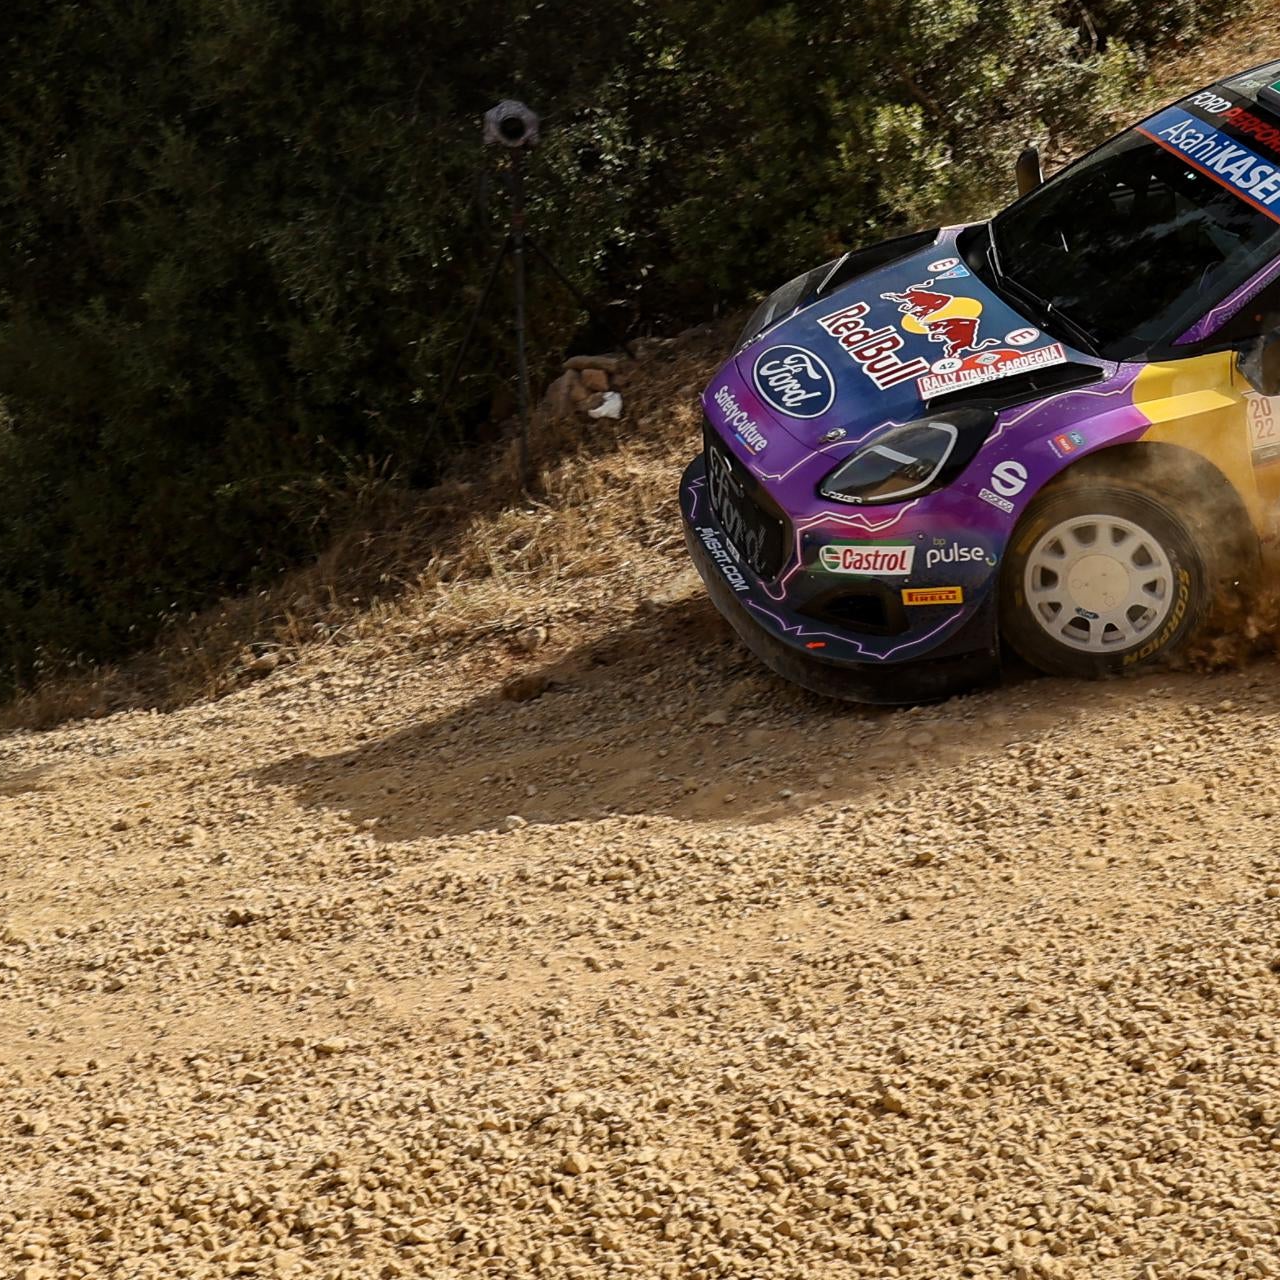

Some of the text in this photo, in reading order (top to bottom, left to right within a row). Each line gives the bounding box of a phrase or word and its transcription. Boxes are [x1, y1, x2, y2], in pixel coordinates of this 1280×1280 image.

[1187, 91, 1233, 114] FORD
[922, 347, 1060, 391] RALLY ITALIA SARDEGNA
[938, 361, 956, 371] 42
[759, 353, 822, 407] Ford
[714, 384, 768, 452] SafetyCulture
[1249, 397, 1271, 419] 20
[1254, 417, 1276, 439] 22
[933, 537, 946, 547] bp
[842, 548, 908, 572] Castrol
[926, 542, 986, 569] pulse
[907, 589, 958, 604] PIRELLI
[1123, 568, 1191, 666] SCORPION
